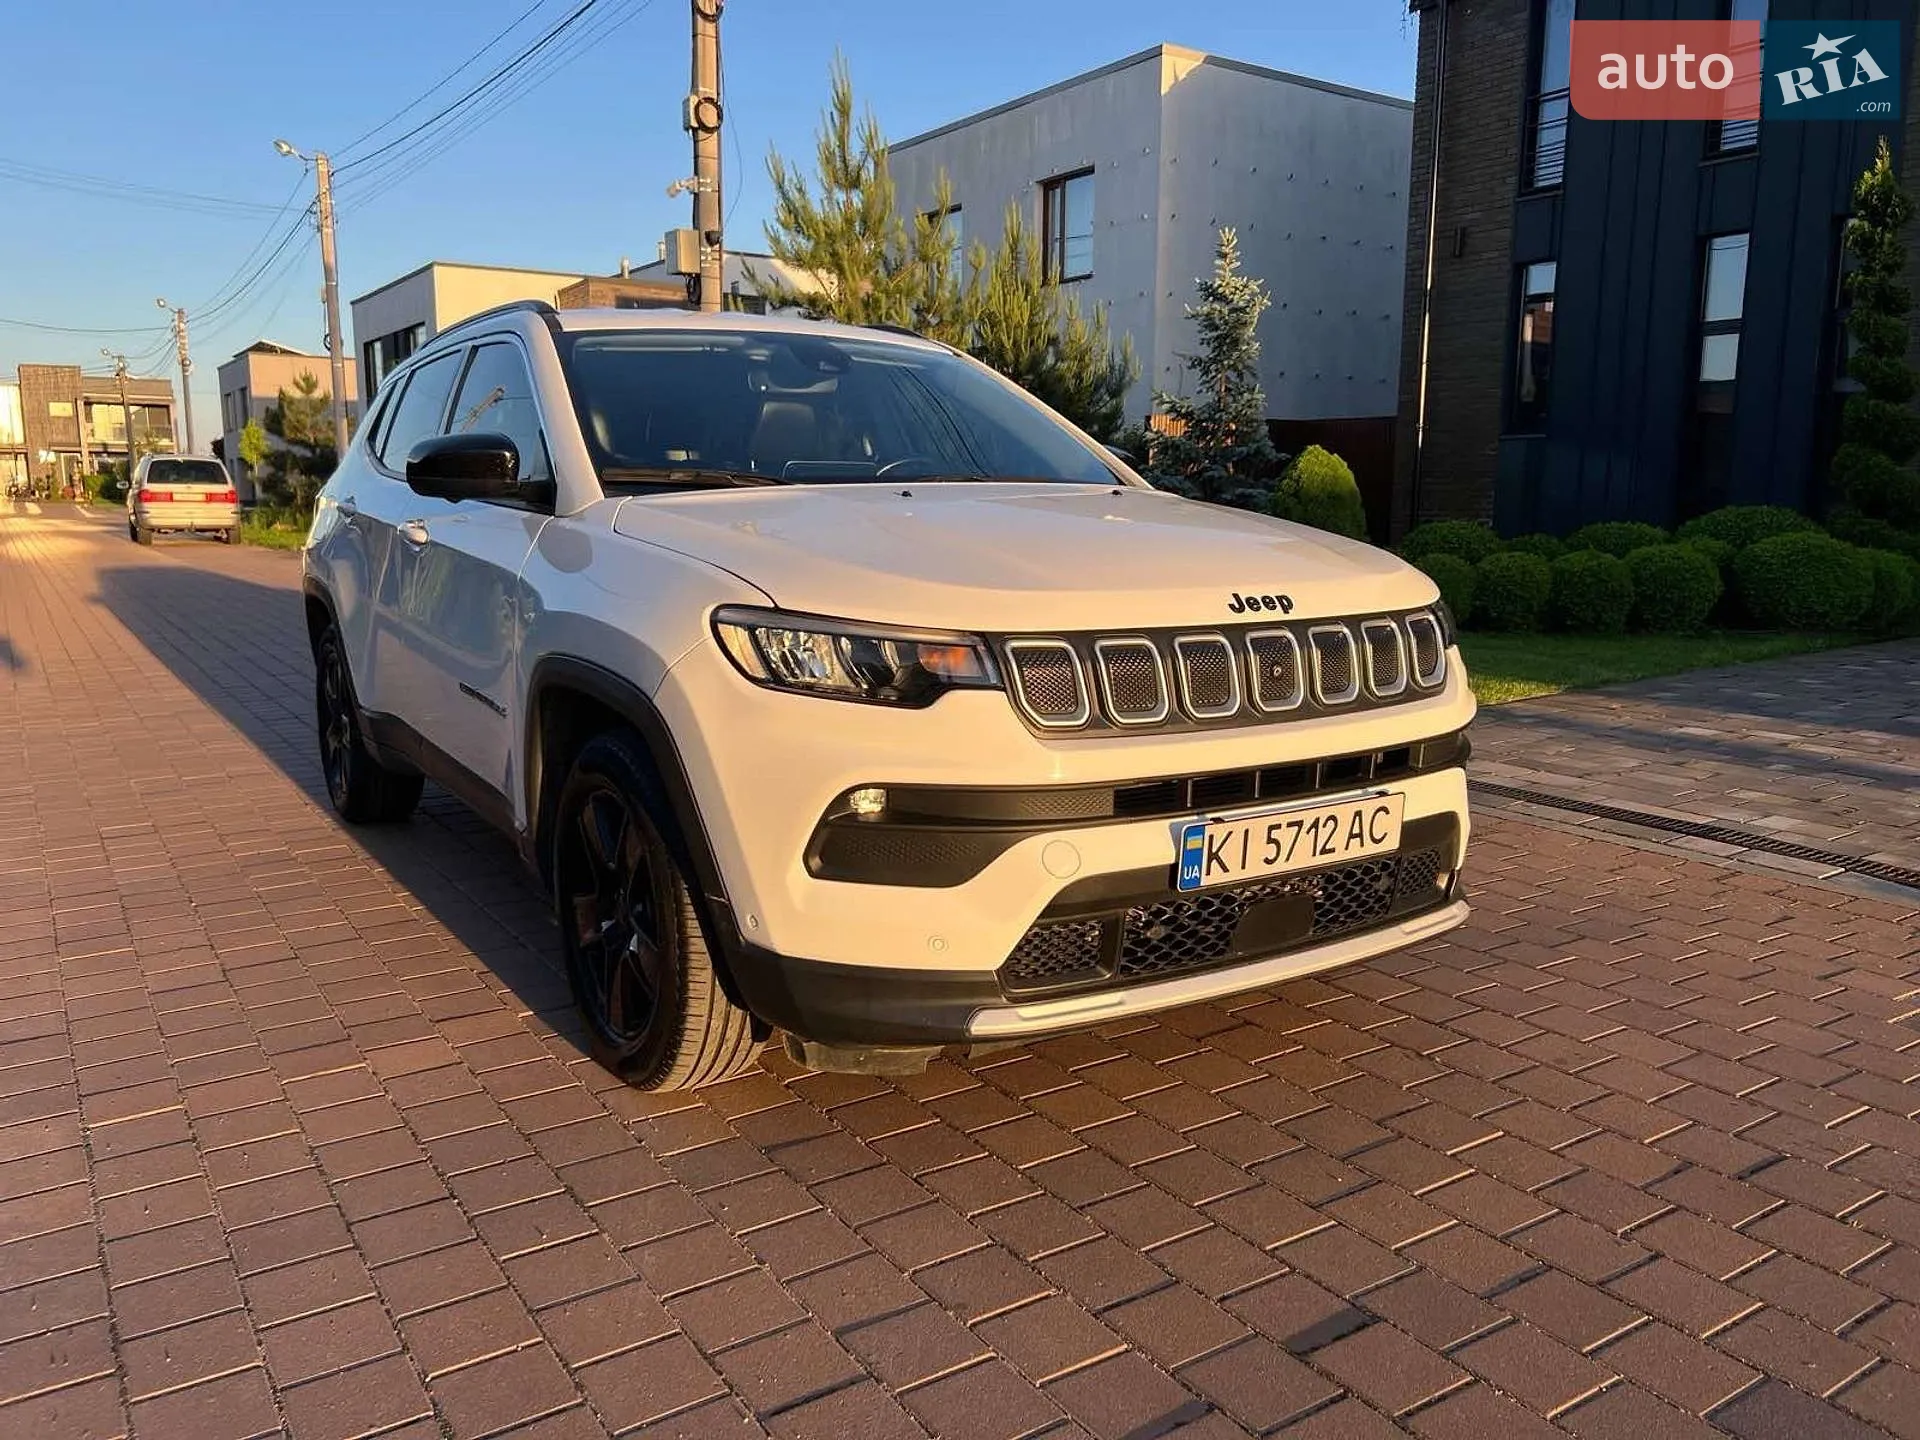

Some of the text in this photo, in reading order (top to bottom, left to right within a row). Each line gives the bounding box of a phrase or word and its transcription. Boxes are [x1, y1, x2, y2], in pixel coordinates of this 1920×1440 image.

[1228, 593, 1294, 614] Jeep
[1205, 805, 1391, 876] KI 5712 AC
[1184, 865, 1200, 881] UA
